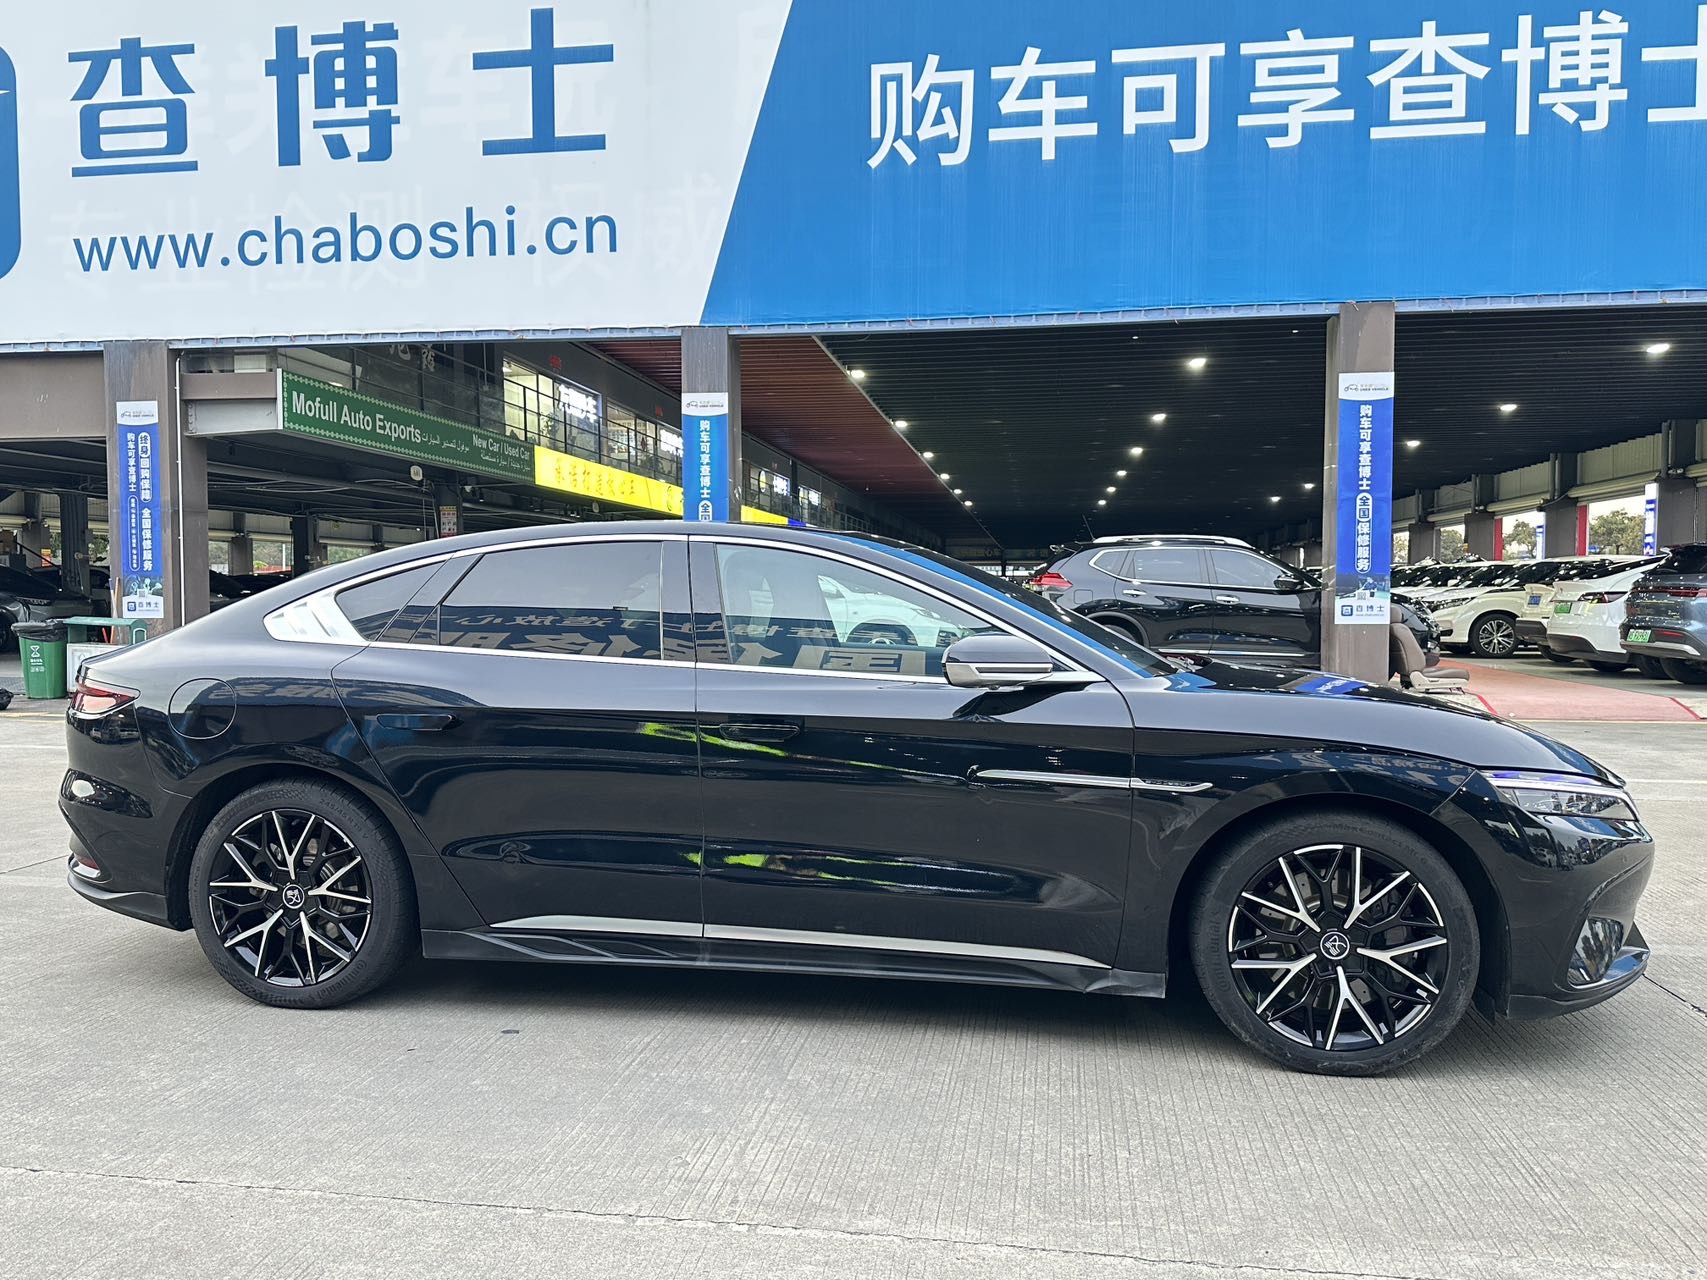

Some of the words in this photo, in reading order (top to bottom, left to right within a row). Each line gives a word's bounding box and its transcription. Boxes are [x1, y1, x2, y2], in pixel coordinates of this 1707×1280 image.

[68, 8, 614, 177] 查博士
[73, 205, 618, 272] www.chaboshi.cn
[292, 390, 337, 423] Mofull
[341, 404, 372, 431] Auto
[376, 413, 421, 443] Exports
[472, 433, 487, 449] New
[488, 438, 500, 452] Car
[504, 442, 519, 458] Used
[520, 447, 530, 460] Car
[1358, 404, 1373, 490] 购车可享查博士
[699, 419, 711, 499] 购车可享查博士
[141, 507, 153, 572] 全国保修服务
[1356, 495, 1370, 570] 全国保修服务
